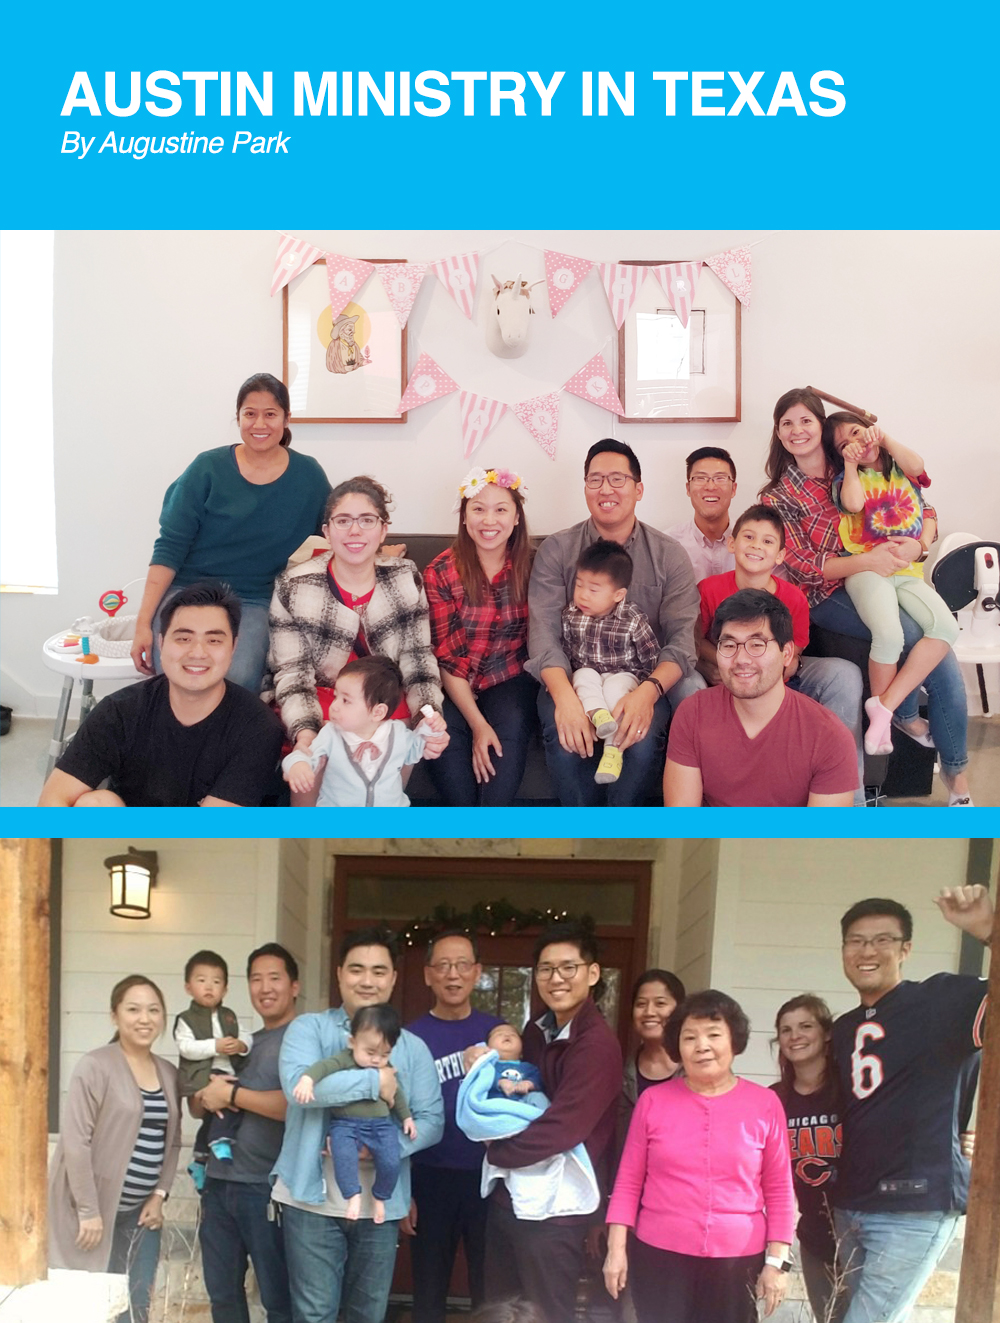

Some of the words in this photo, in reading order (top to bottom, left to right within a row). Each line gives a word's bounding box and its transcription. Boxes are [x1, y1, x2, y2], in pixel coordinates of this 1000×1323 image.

[851, 1021, 885, 1100] 6
[788, 1114, 838, 1127] HICAGO
[787, 1123, 842, 1160] EARS
